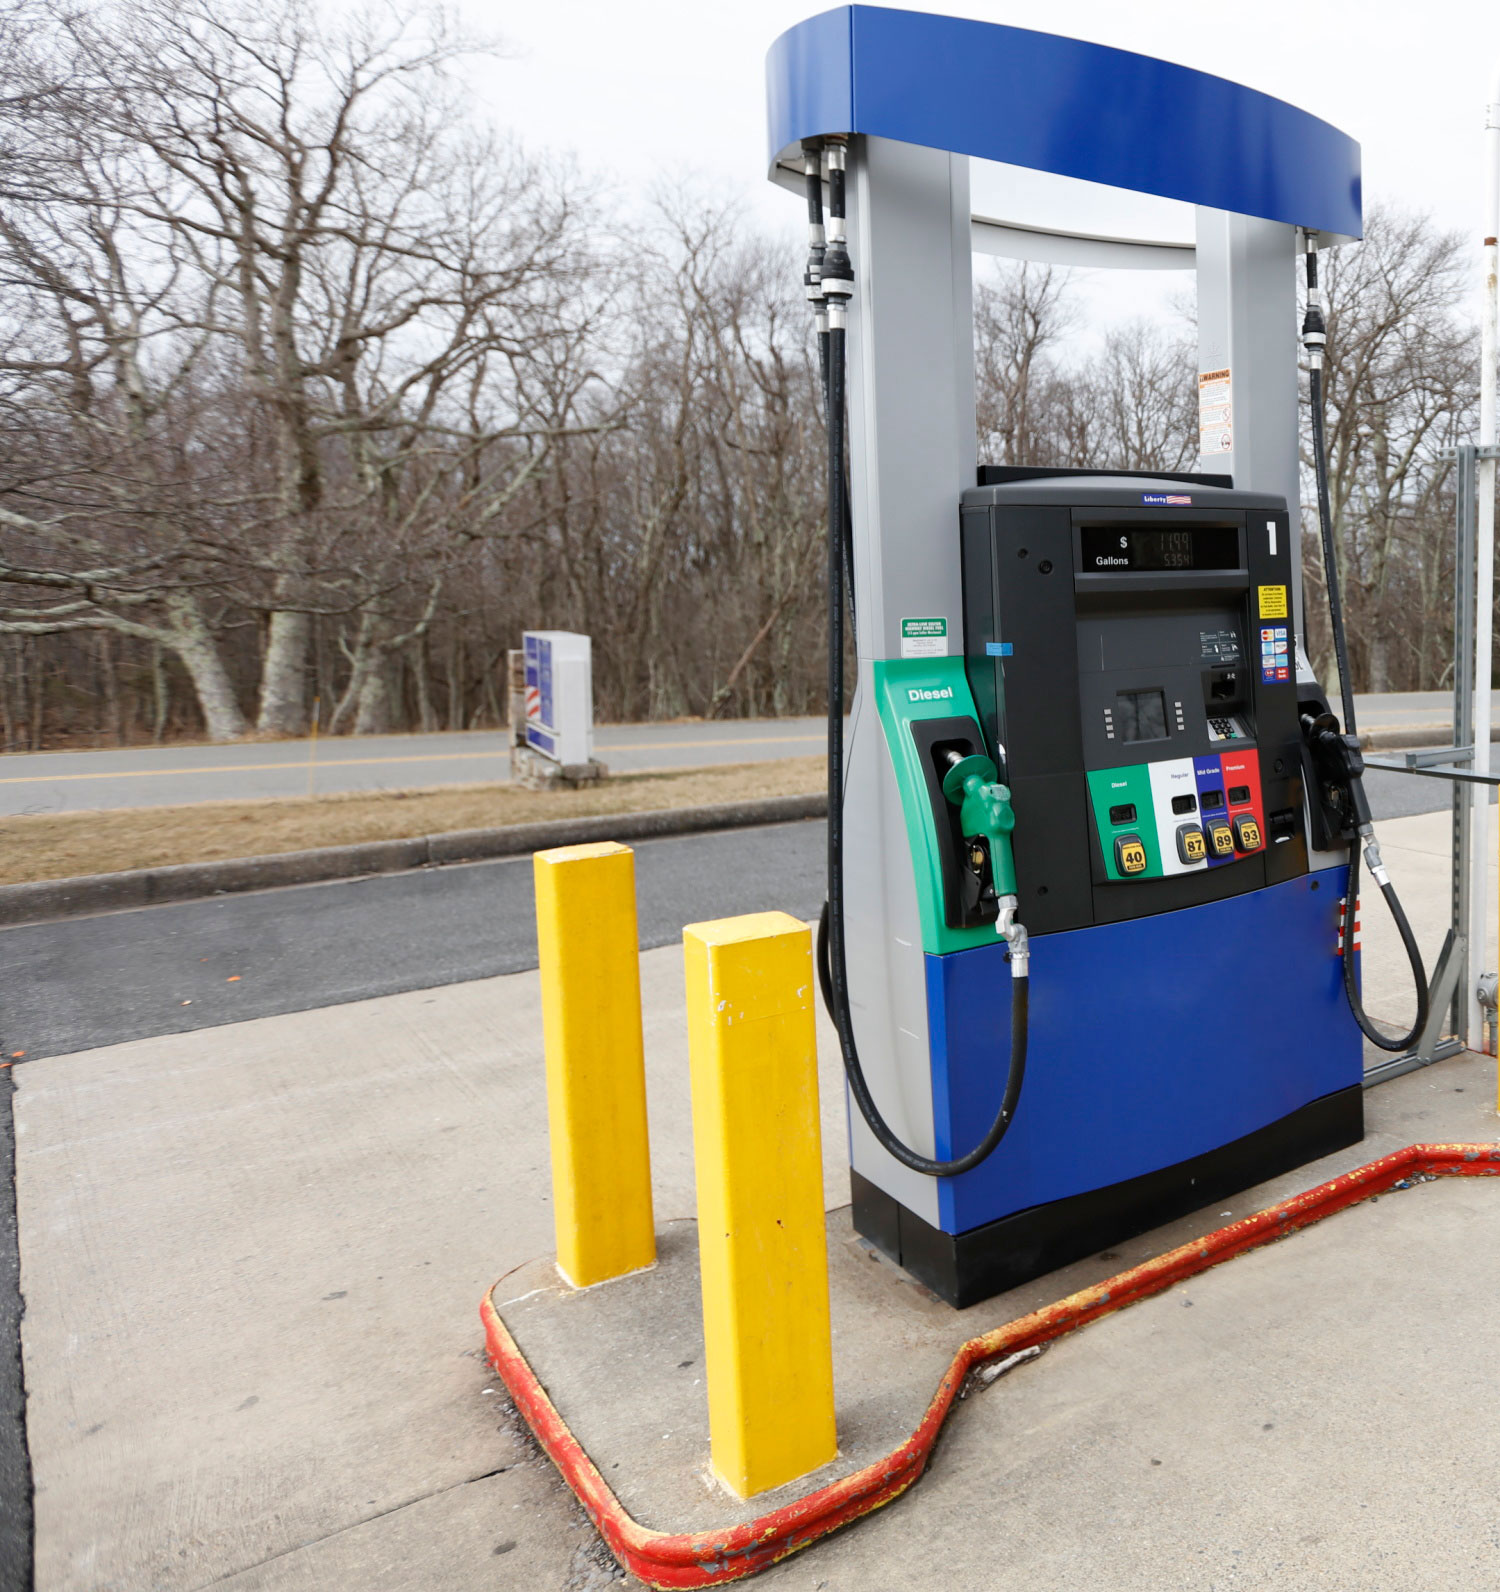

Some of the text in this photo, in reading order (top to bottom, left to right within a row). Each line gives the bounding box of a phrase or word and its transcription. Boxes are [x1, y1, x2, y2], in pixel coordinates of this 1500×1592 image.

[1204, 369, 1230, 381] WARNING
[1143, 495, 1166, 504] Liberty
[1120, 535, 1128, 549] $
[1266, 521, 1277, 555] 1
[1095, 556, 1129, 566] Gallons
[908, 686, 953, 701] Diesel
[1170, 772, 1189, 780] Regular
[1196, 767, 1220, 776] Mid Grade
[1111, 780, 1128, 788] Diesel
[1216, 834, 1231, 847] 89
[1243, 829, 1258, 842] 93
[1187, 839, 1202, 852] 87
[1125, 851, 1142, 864] 40
